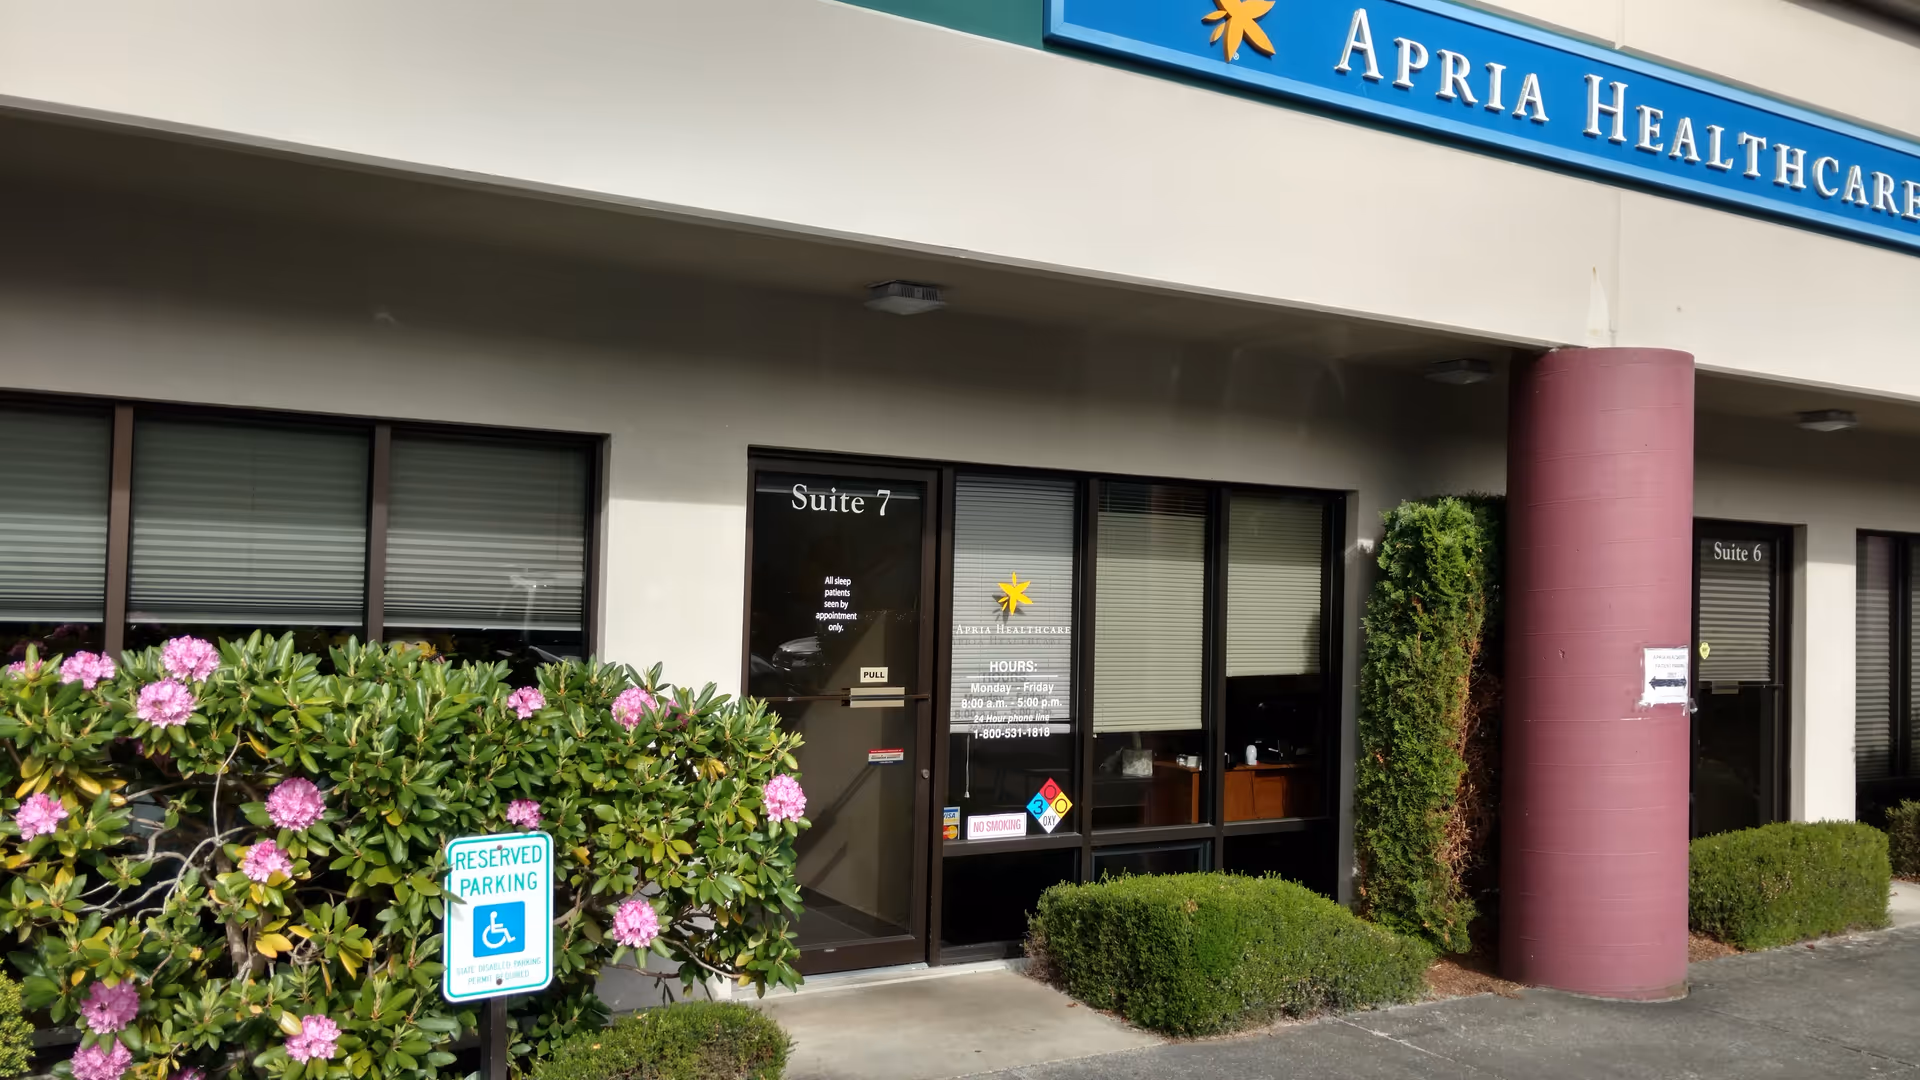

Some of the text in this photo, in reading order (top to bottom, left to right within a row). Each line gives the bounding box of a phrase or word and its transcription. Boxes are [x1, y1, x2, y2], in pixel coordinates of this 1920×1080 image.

[1334, 8, 1920, 221] APRIA HEALTHCARE
[792, 483, 891, 516] Suite 7
[1714, 541, 1762, 562] Suite 6
[825, 576, 852, 587] All sleep
[825, 588, 850, 598] patients
[824, 600, 849, 610] seen by
[815, 612, 858, 622] appointment
[828, 623, 844, 633] only.
[955, 624, 1071, 635] APRIA HEALTHCARE
[989, 660, 1038, 673] HOURS:
[863, 671, 885, 679] PULL
[970, 683, 1012, 695] Monday
[1023, 682, 1055, 694] Friday
[961, 699, 984, 708] 8:00
[986, 699, 1008, 708] a.m.
[1017, 697, 1038, 707] 5:00
[1041, 697, 1062, 708] p.m.
[973, 713, 1050, 724] 24 Hour phone line
[973, 726, 1051, 739] 1-800-531-1818
[1033, 800, 1043, 815] 3
[973, 818, 1022, 833] NO SMOKING
[1042, 815, 1056, 827] OXY
[455, 845, 542, 870] RESERVED
[460, 871, 537, 896] PARKING
[478, 961, 511, 972] DISABLED
[467, 974, 493, 985] PERMIT
